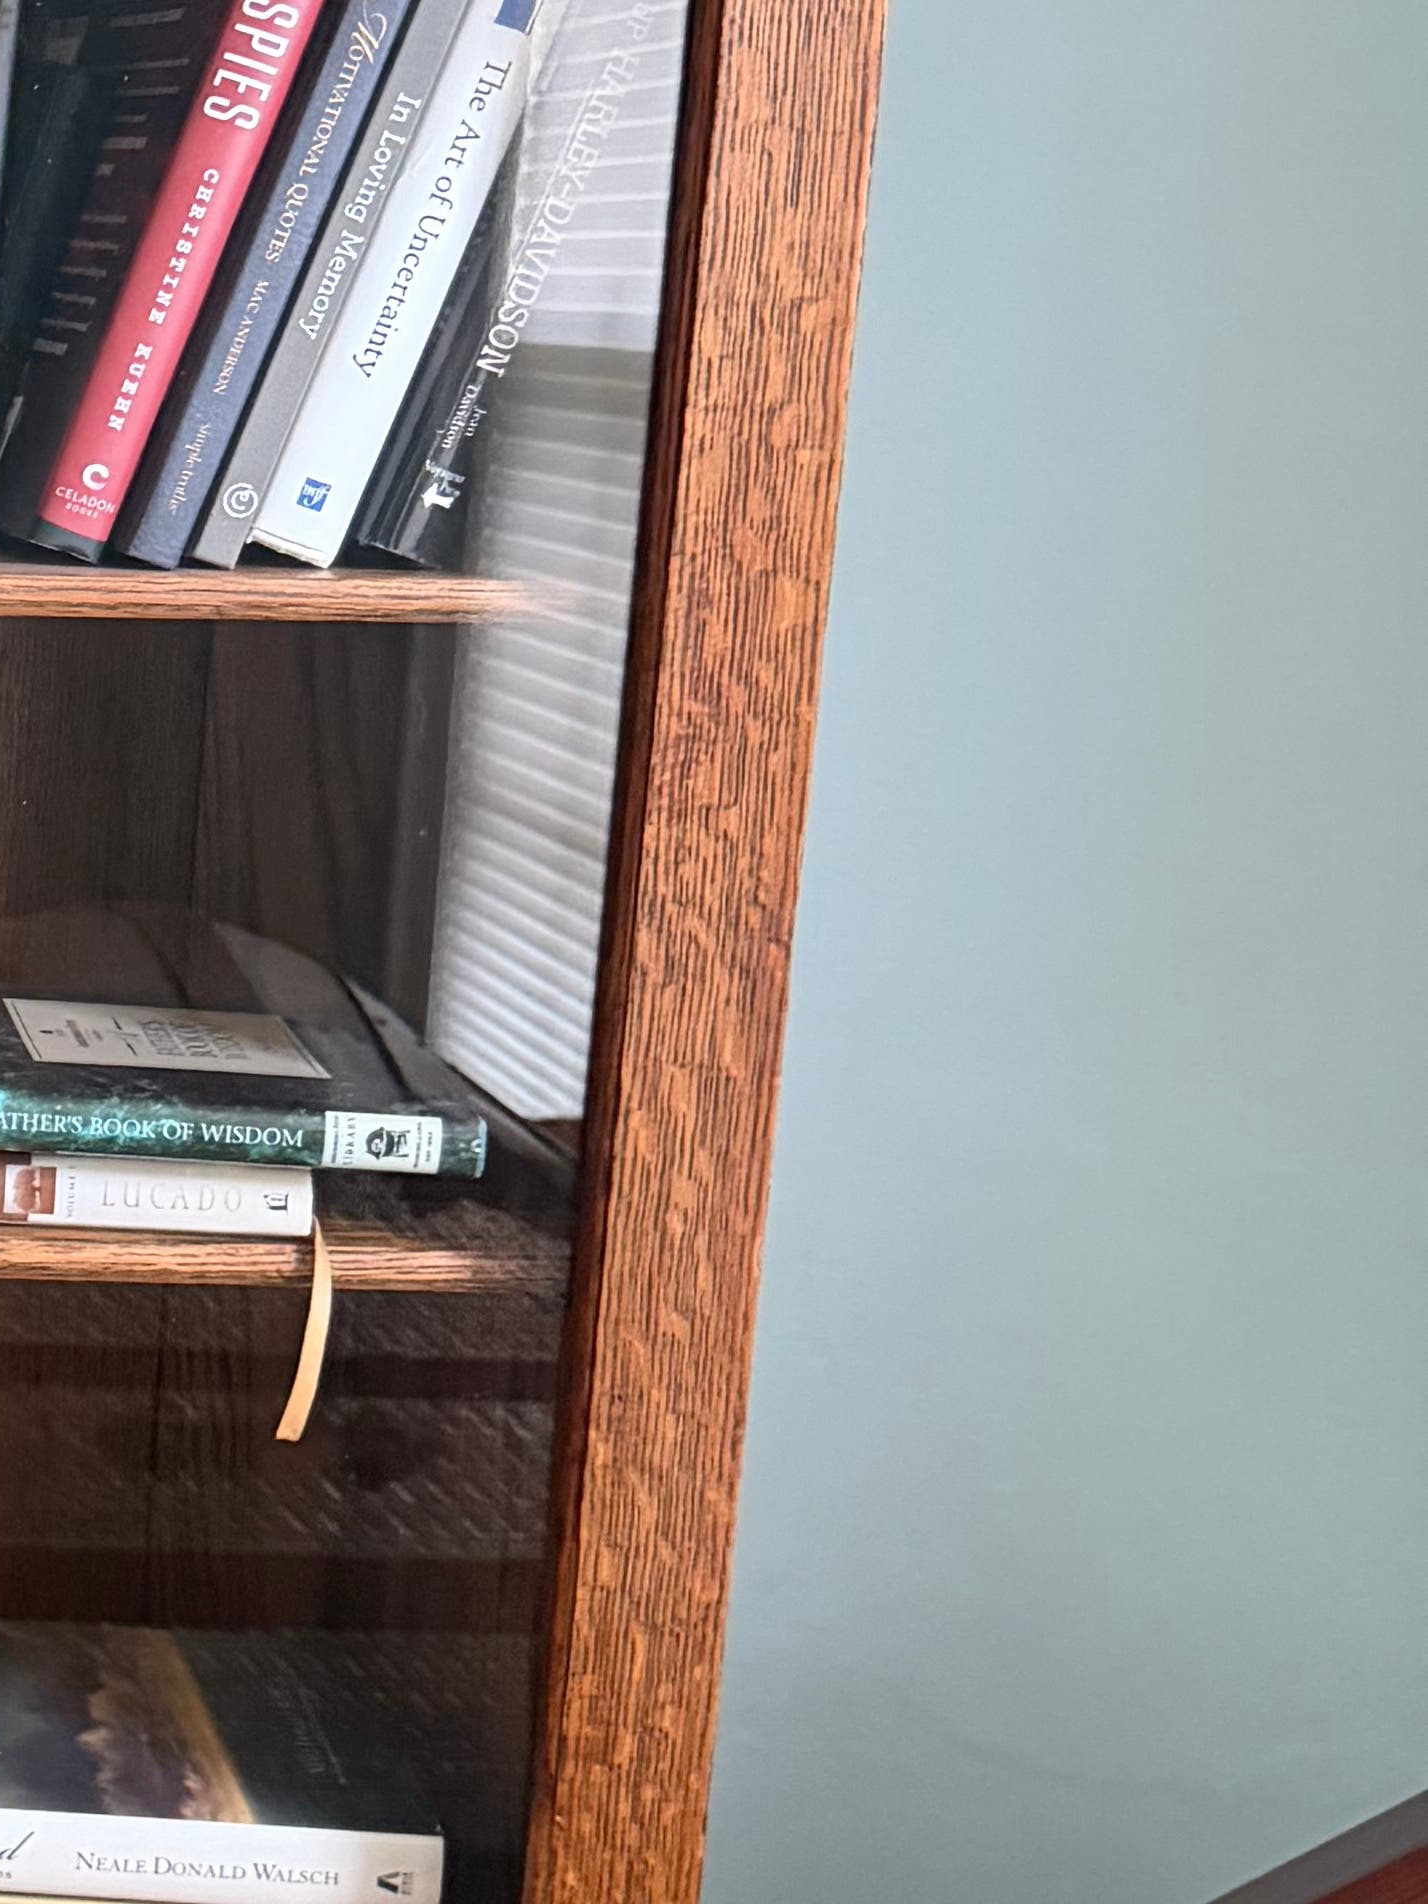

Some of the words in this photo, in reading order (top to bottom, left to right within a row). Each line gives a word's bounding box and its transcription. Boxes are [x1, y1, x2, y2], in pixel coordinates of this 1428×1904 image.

[390, 92, 422, 122] In
[469, 59, 513, 112] The
[344, 128, 411, 222] Loving
[444, 119, 482, 169] Art
[265, 183, 310, 264] QUOTES
[433, 176, 462, 210] of
[479, 44, 641, 379] HARLEY-DAVIDSON
[148, 168, 219, 325] CHRISTINE
[298, 231, 365, 341] Memory
[353, 214, 446, 379] Uncertainty
[107, 342, 153, 432] KUEHN
[213, 316, 256, 396] ANDERSON
[55, 486, 116, 515] CELADON
[89, 1115, 157, 1139] BOOK
[162, 1118, 195, 1142] OF
[200, 1122, 305, 1149] WISDOM
[100, 1179, 244, 1214] LUCADO
[74, 1850, 148, 1874] NEALE
[152, 1855, 247, 1881] DONALD
[252, 1863, 341, 1886] WALSCH
